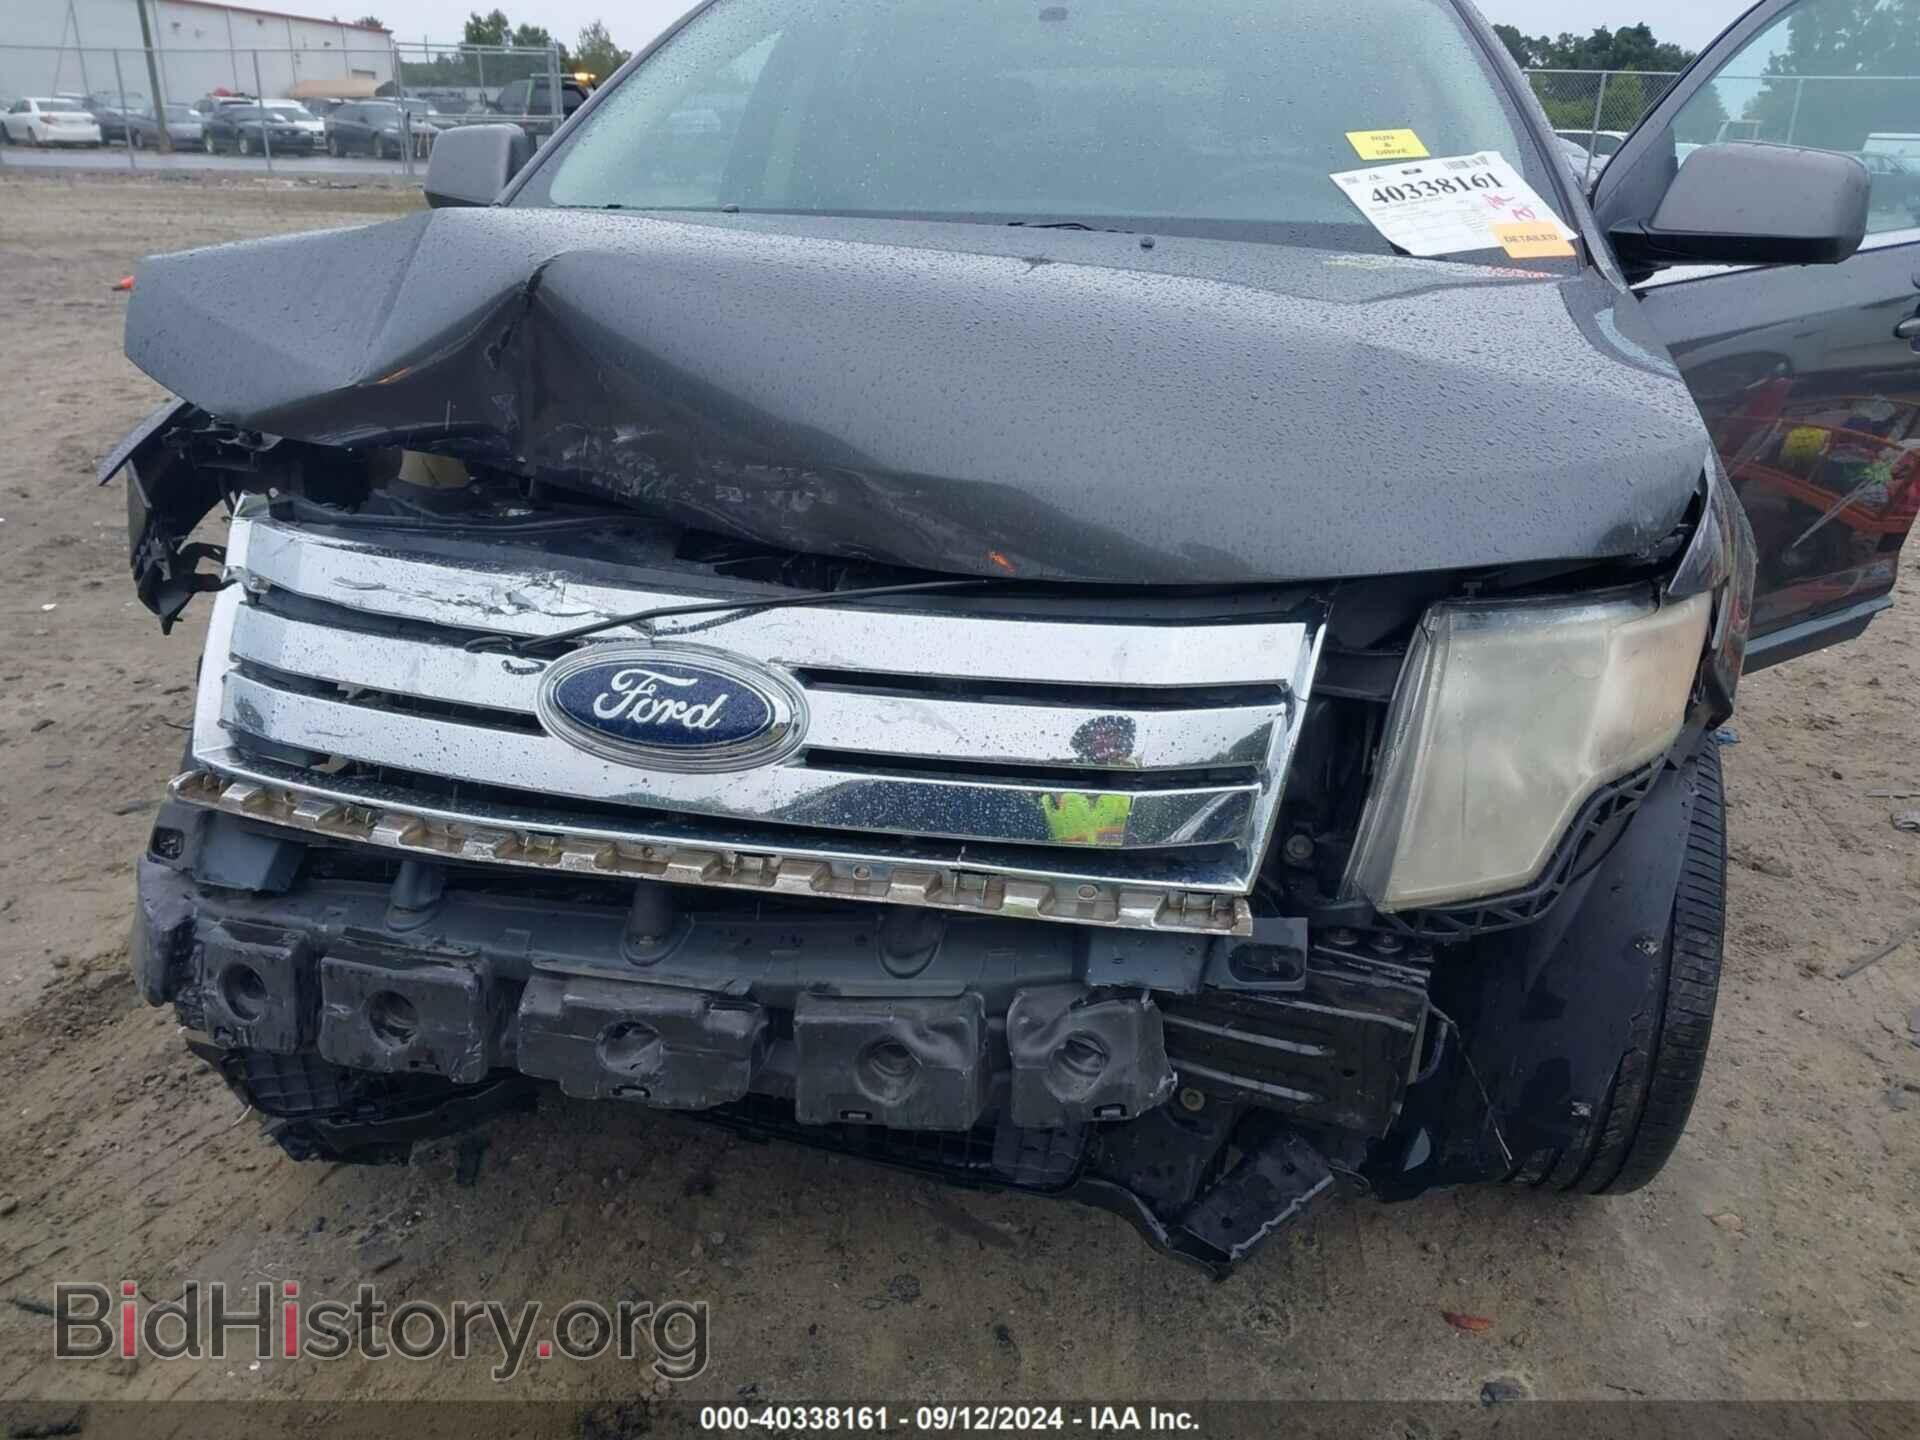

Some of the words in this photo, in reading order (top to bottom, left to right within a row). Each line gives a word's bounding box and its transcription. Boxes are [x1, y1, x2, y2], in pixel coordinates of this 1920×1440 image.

[1371, 171, 1504, 204] 40338161
[1503, 233, 1558, 243] DETAILED
[593, 668, 728, 730] Ford
